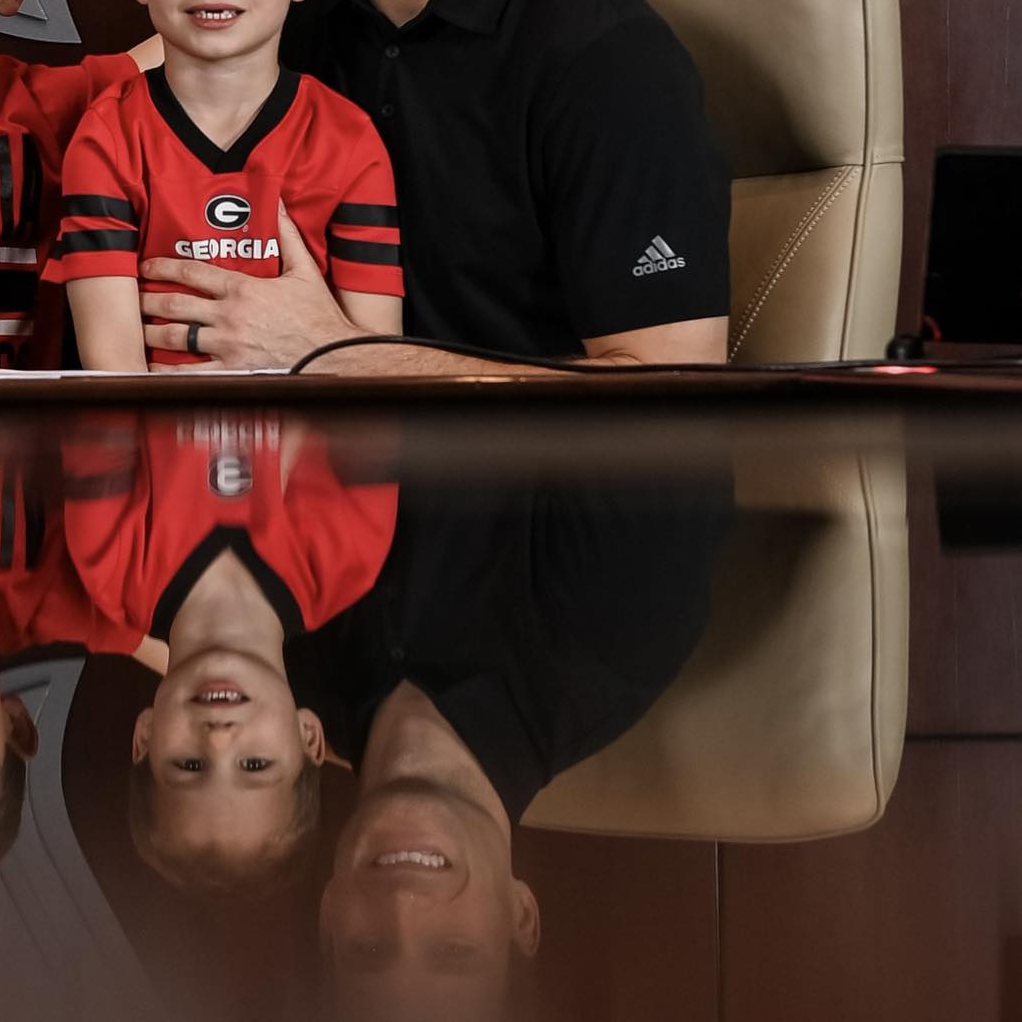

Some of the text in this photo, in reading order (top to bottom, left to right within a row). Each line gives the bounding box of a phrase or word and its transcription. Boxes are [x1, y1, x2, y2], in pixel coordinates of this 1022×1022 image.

[206, 196, 250, 229] G
[175, 238, 279, 259] GEORGIA
[632, 257, 686, 276] adidas
